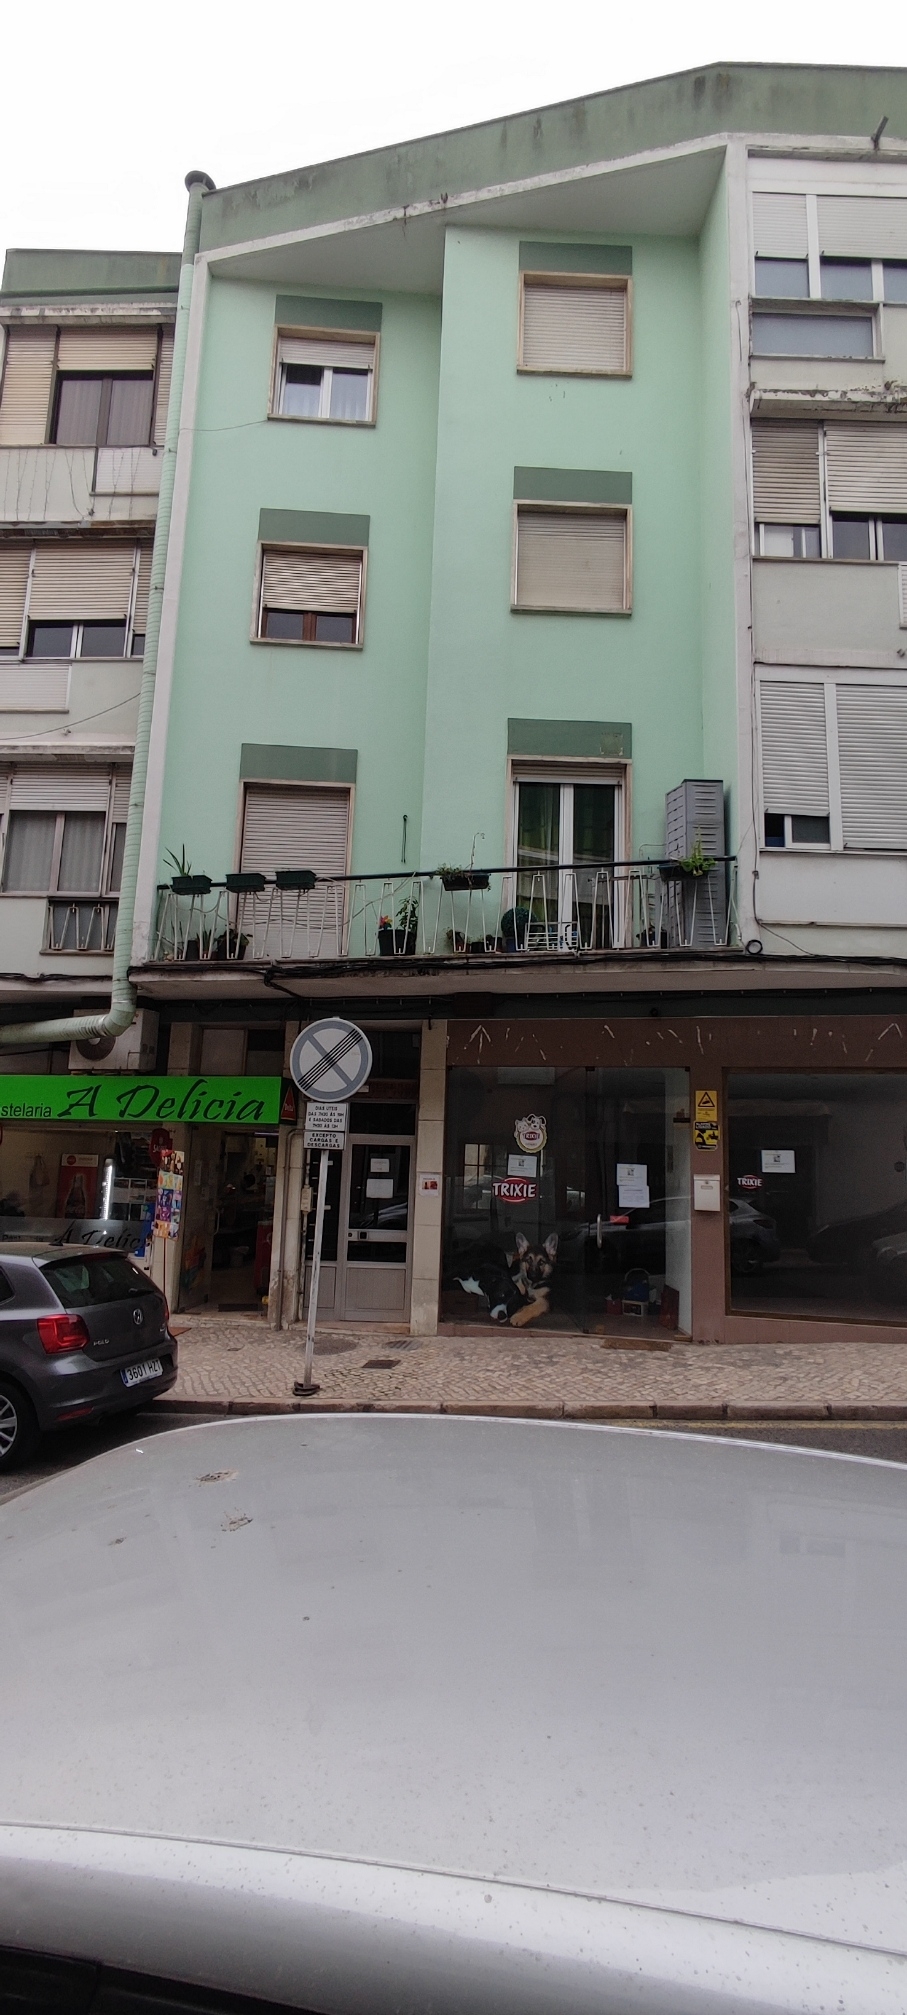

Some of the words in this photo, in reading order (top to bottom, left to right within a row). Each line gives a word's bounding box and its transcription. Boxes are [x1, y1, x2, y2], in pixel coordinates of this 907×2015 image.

[57, 1084, 103, 1118] A
[116, 1078, 265, 1121] Delicia
[492, 1182, 537, 1198] TRIXIE
[737, 1177, 763, 1187] TRIXIE
[127, 1364, 147, 1381] 3601
